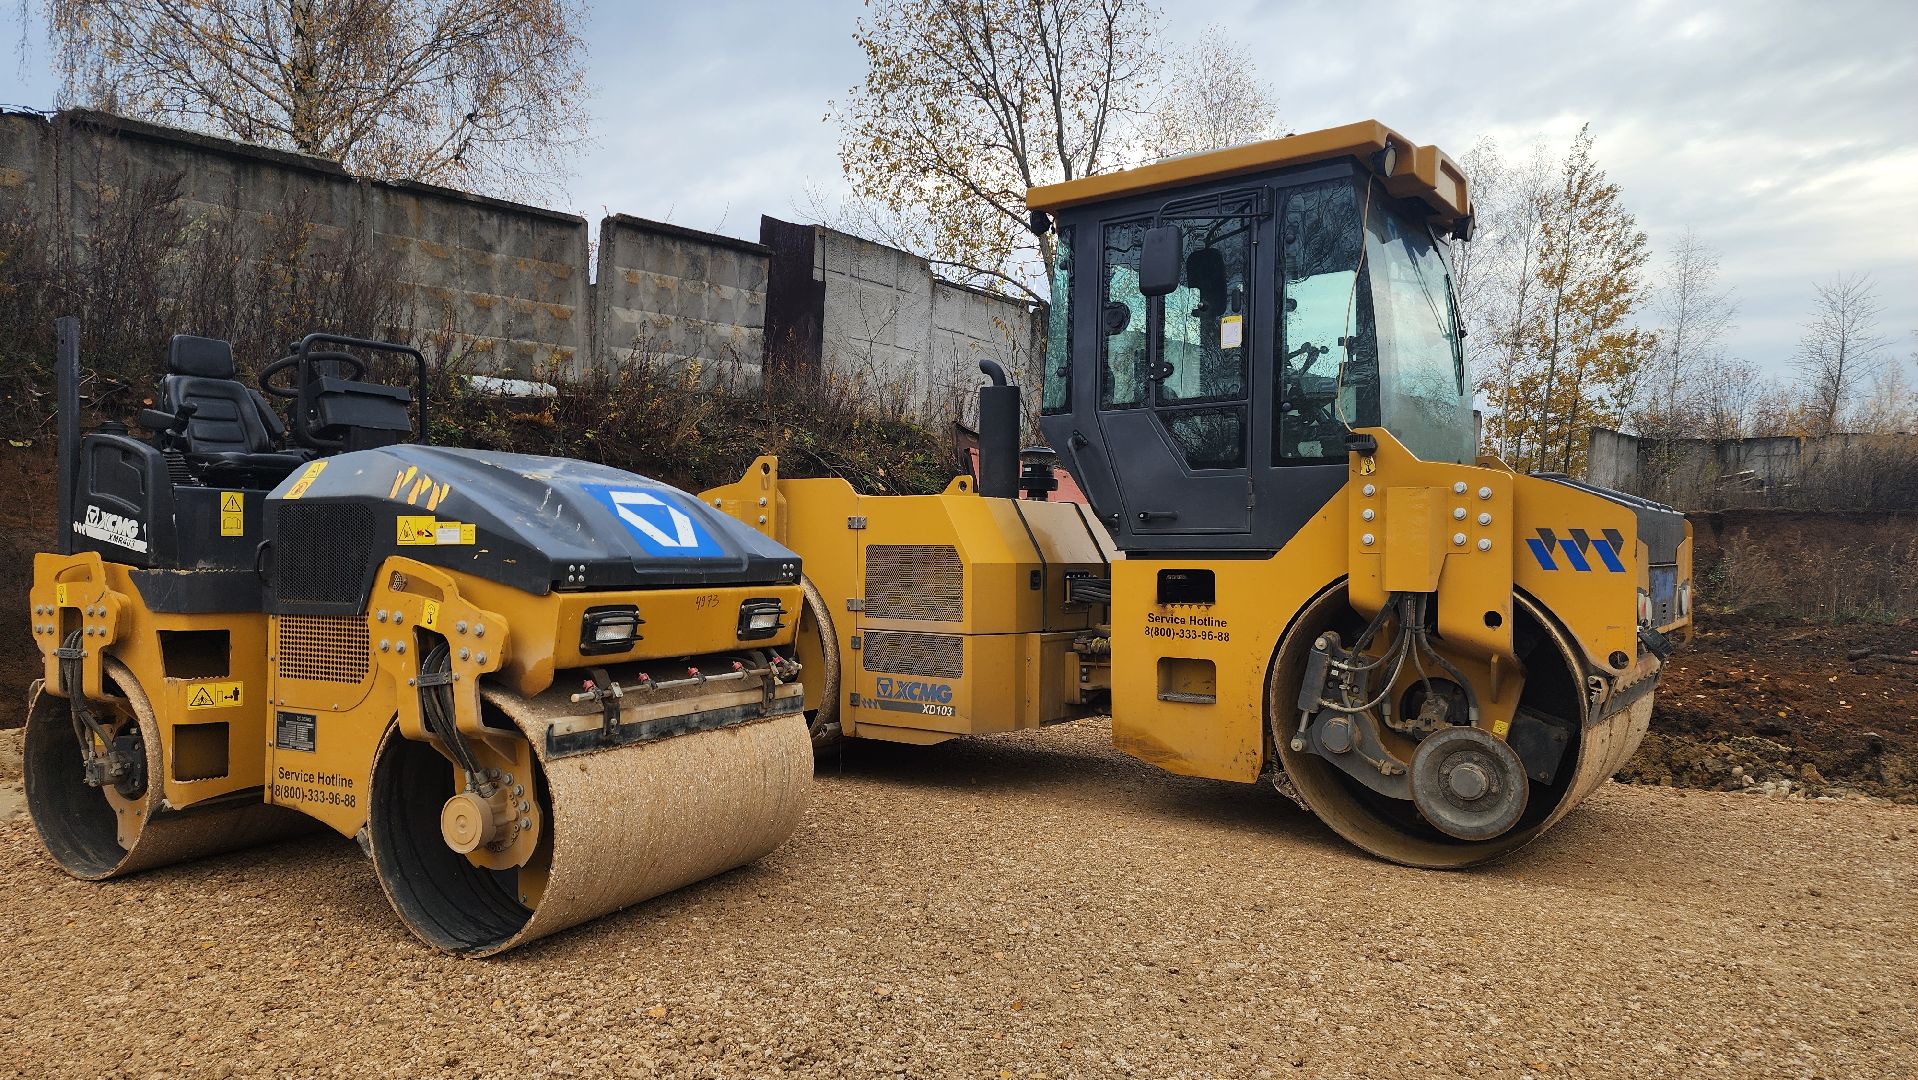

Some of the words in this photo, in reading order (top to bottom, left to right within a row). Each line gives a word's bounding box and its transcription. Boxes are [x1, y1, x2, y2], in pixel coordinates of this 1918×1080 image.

[98, 511, 139, 539] XCMG
[1147, 613, 1186, 625] Service
[1189, 616, 1228, 628] Hotline
[1144, 626, 1230, 642] 8(800)-333-96-88
[893, 680, 953, 704] XCMG
[922, 703, 953, 716] XD103
[278, 766, 315, 784] Service
[317, 771, 354, 789] Hotline
[274, 784, 356, 808] 8(800)-333-96-88
